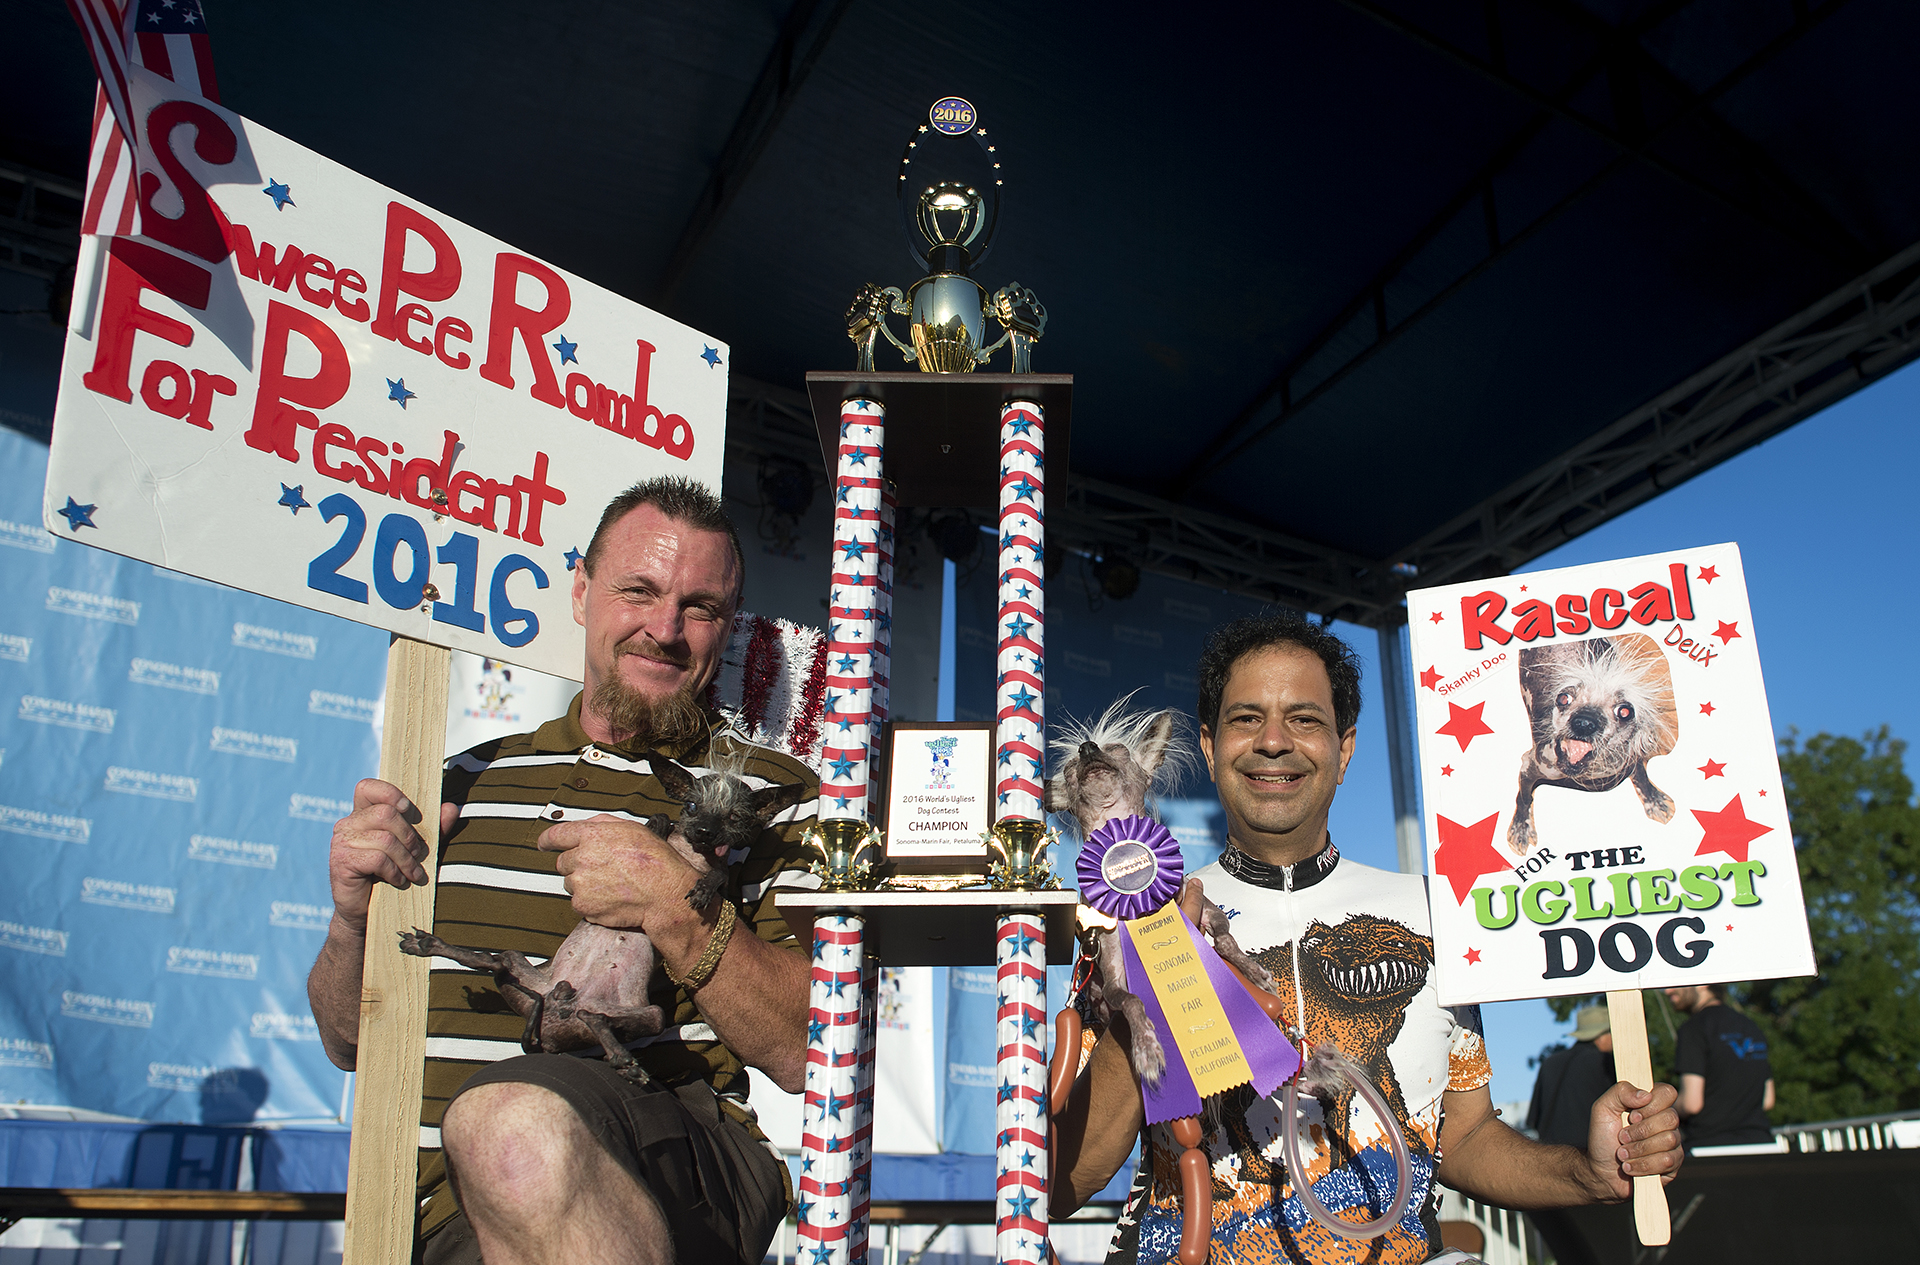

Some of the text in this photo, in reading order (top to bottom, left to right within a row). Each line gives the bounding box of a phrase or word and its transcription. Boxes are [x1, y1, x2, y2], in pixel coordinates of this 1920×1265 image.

[934, 107, 972, 123] 2016
[83, 236, 566, 547] For President
[308, 493, 549, 647] 2016
[1460, 562, 1695, 651] Rascal
[1438, 652, 1507, 696] Skanky Doo
[903, 795, 975, 804] 2016 World's Ugliest
[917, 807, 930, 816] Dog
[908, 821, 968, 831] CHAMPION
[1514, 845, 1646, 883] FOR THE
[1470, 860, 1767, 930] UGLIEST
[1138, 914, 1176, 936] PARTICIPANT
[1540, 917, 1714, 979] DOG
[1153, 951, 1193, 974] SONOMA
[1166, 975, 1198, 994] MARIN
[1180, 997, 1203, 1013] FAIR
[1189, 1036, 1231, 1059] PETALUMA
[1194, 1052, 1241, 1076] CALIFORNIA
